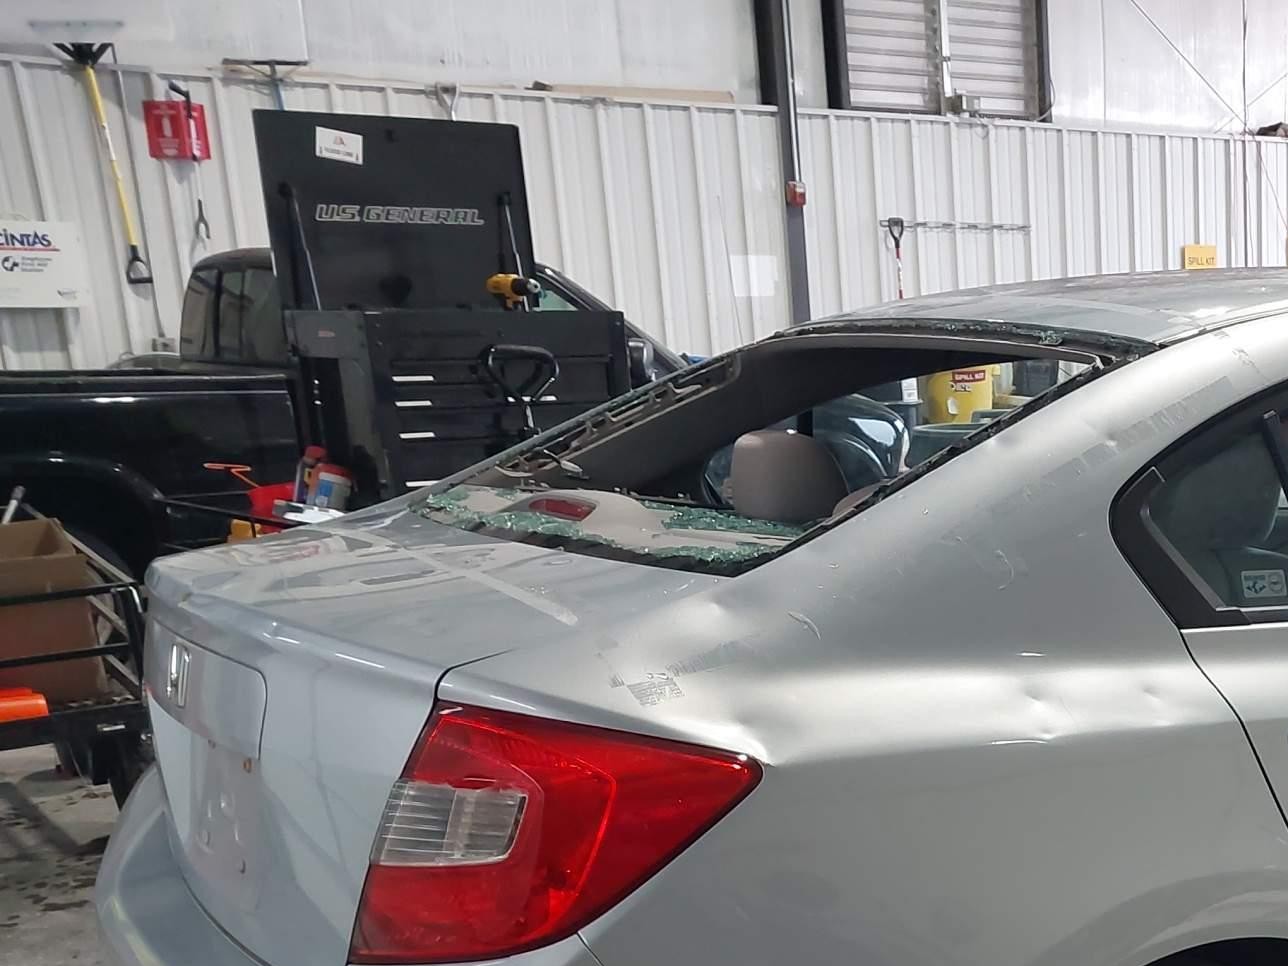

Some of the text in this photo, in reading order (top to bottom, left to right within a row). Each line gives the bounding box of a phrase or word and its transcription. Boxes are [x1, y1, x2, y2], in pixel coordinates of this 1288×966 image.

[364, 206, 485, 226] GENERAL
[1188, 256, 1215, 266] SPILL KIT
